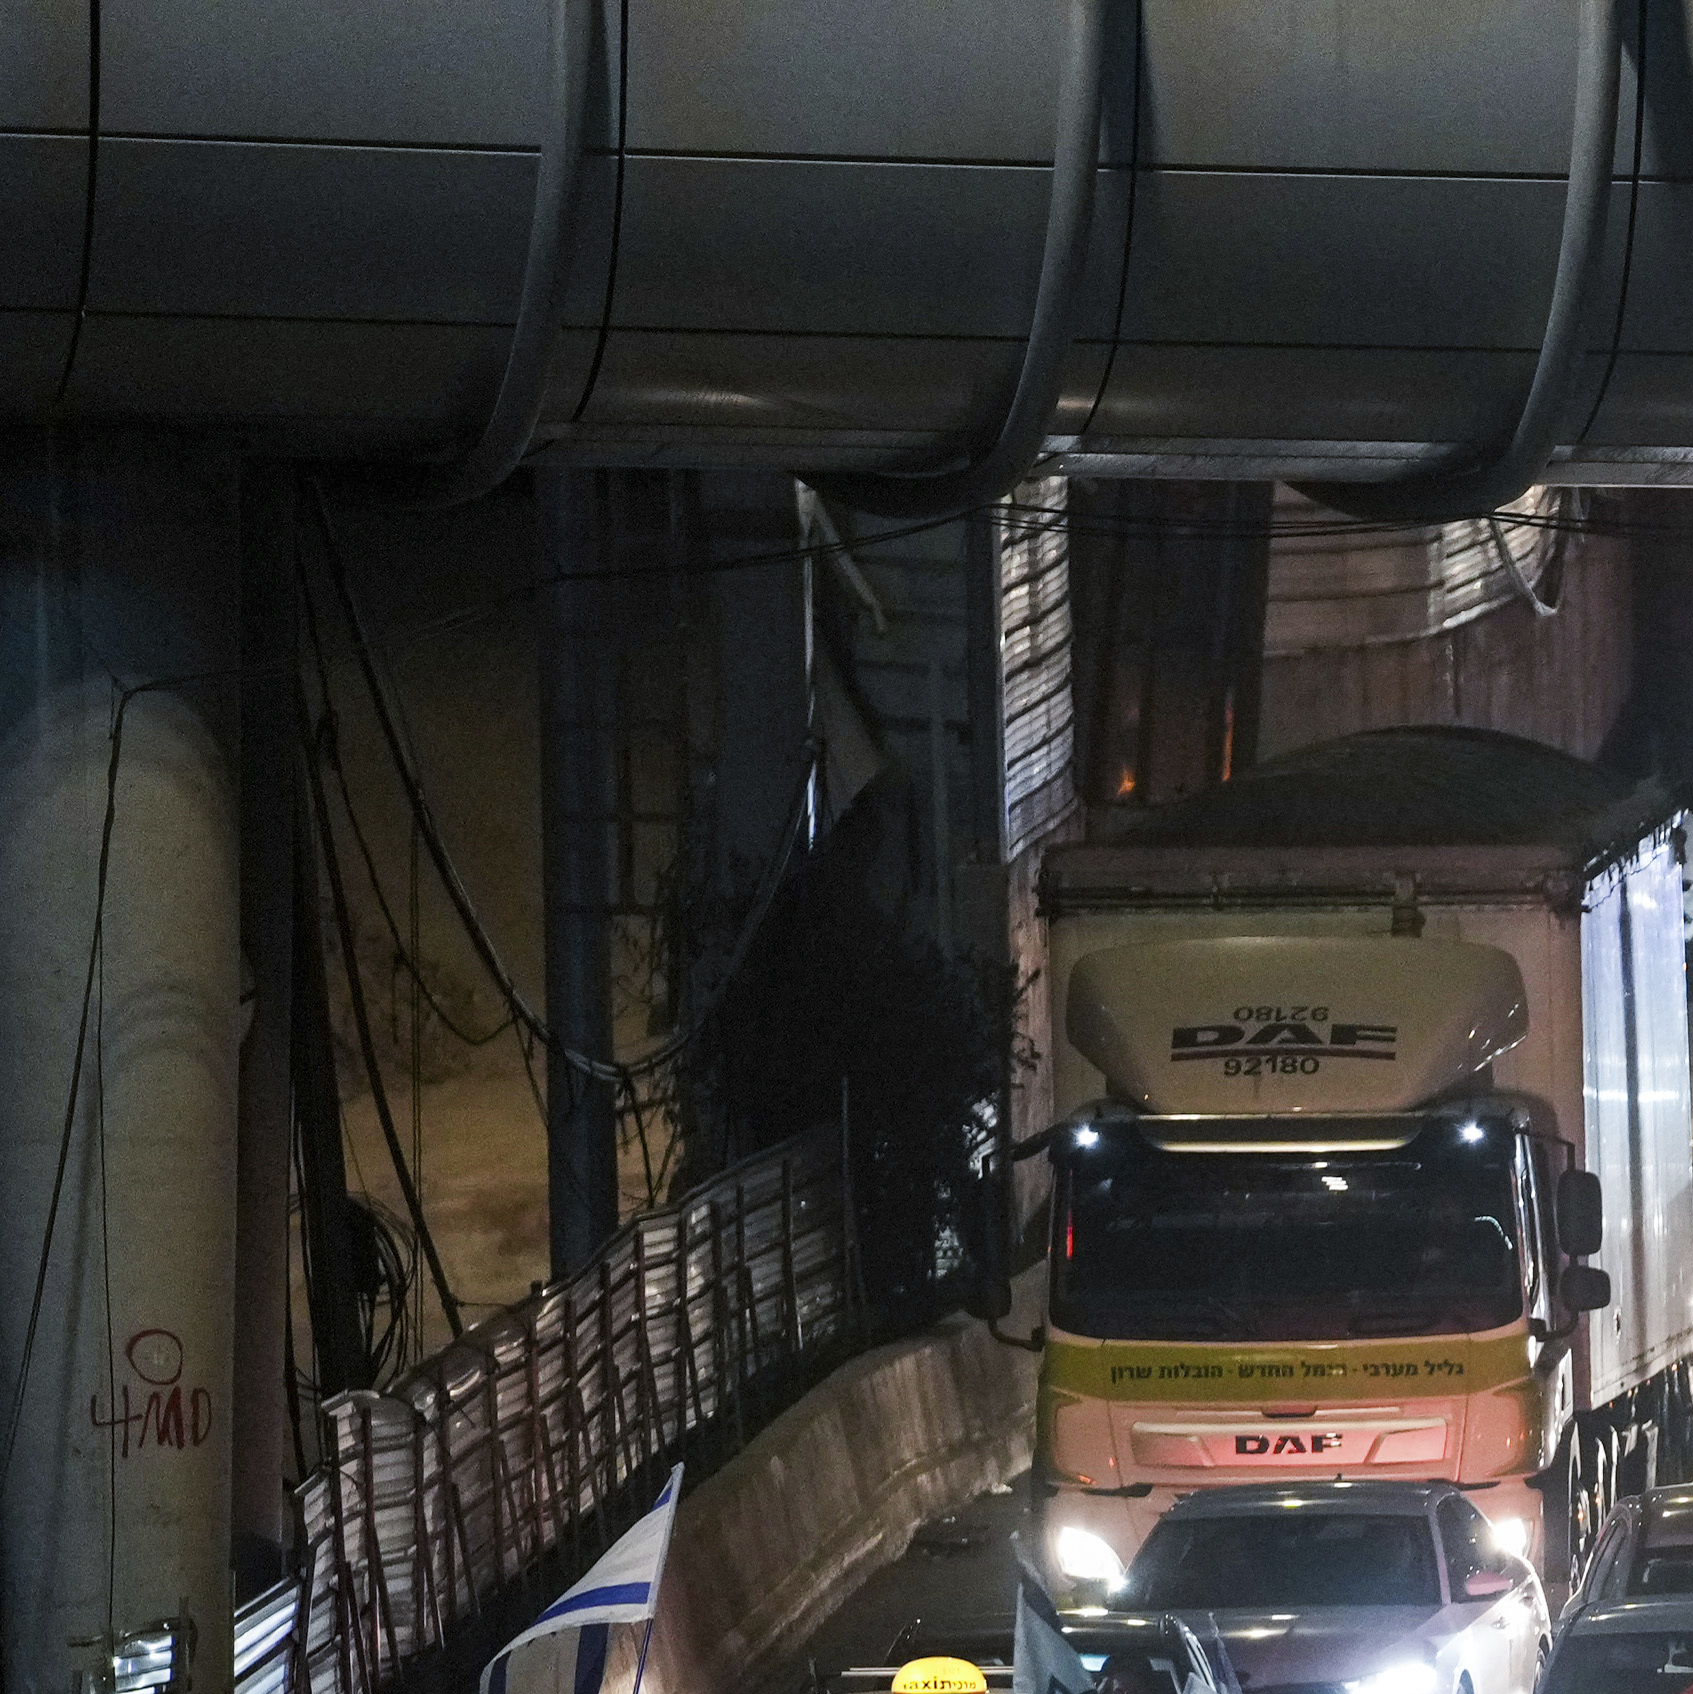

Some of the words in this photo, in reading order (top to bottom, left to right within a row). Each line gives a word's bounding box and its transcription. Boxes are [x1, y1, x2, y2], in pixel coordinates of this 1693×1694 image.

[1171, 1022, 1398, 1049] DAF
[1223, 1055, 1320, 1077] 92180
[1110, 1365, 1152, 1385] שרון
[1424, 1358, 1465, 1376] גליל
[1235, 1434, 1343, 1455] DAF
